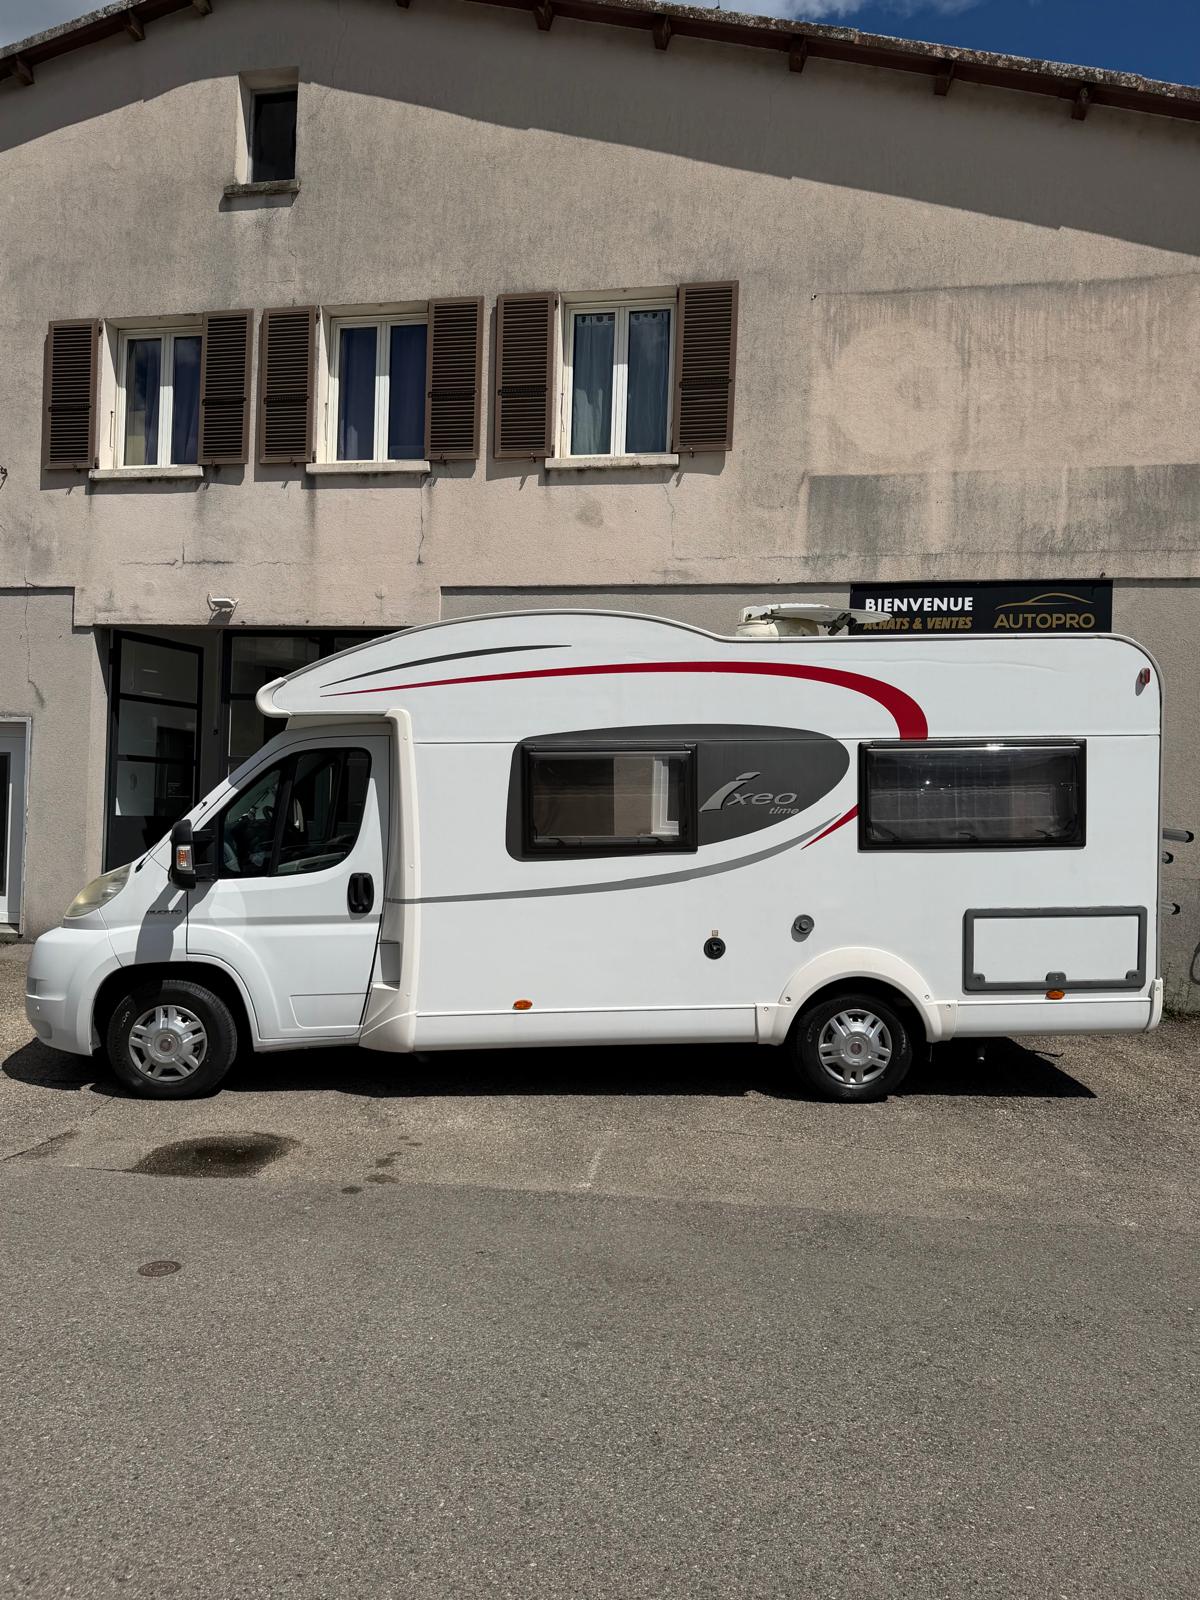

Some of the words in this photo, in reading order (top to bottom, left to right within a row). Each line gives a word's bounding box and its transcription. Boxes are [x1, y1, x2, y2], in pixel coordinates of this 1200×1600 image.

[865, 597, 974, 612] BIENVENUE
[912, 617, 923, 630] &
[926, 616, 973, 630] VENTES
[993, 612, 1096, 629] AUTOPRO
[769, 806, 800, 815] time
